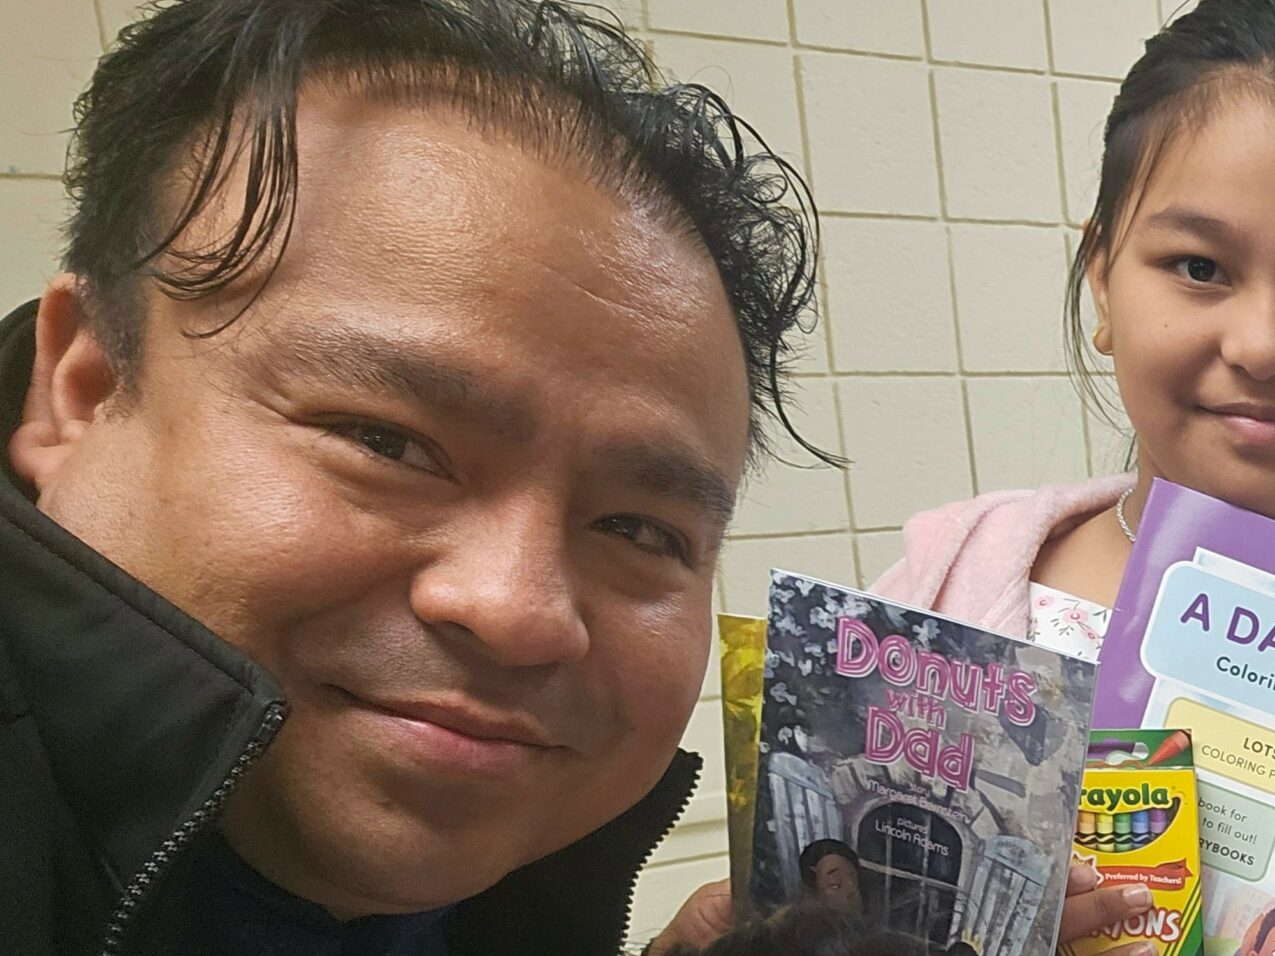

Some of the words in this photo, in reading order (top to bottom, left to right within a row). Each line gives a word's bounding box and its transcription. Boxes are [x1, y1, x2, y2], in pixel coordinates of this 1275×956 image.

[1180, 593, 1210, 632] A
[836, 617, 1037, 726] Donuts
[884, 688, 946, 729] with
[865, 704, 974, 793] Dad
[1201, 744, 1266, 776] COLORING
[1080, 783, 1169, 811] rayola
[1198, 797, 1226, 816] book
[1230, 809, 1248, 822] for
[875, 819, 912, 842] Lincoln
[912, 833, 949, 856] Adams
[1202, 817, 1214, 829] to
[1217, 822, 1232, 835] fill
[1234, 831, 1257, 845] out!
[1199, 837, 1255, 866] RYBOOKS
[1105, 873, 1139, 881] Preferred
[1140, 873, 1149, 882] by
[1150, 874, 1182, 885] Teachers!
[1092, 908, 1181, 942] ONS
